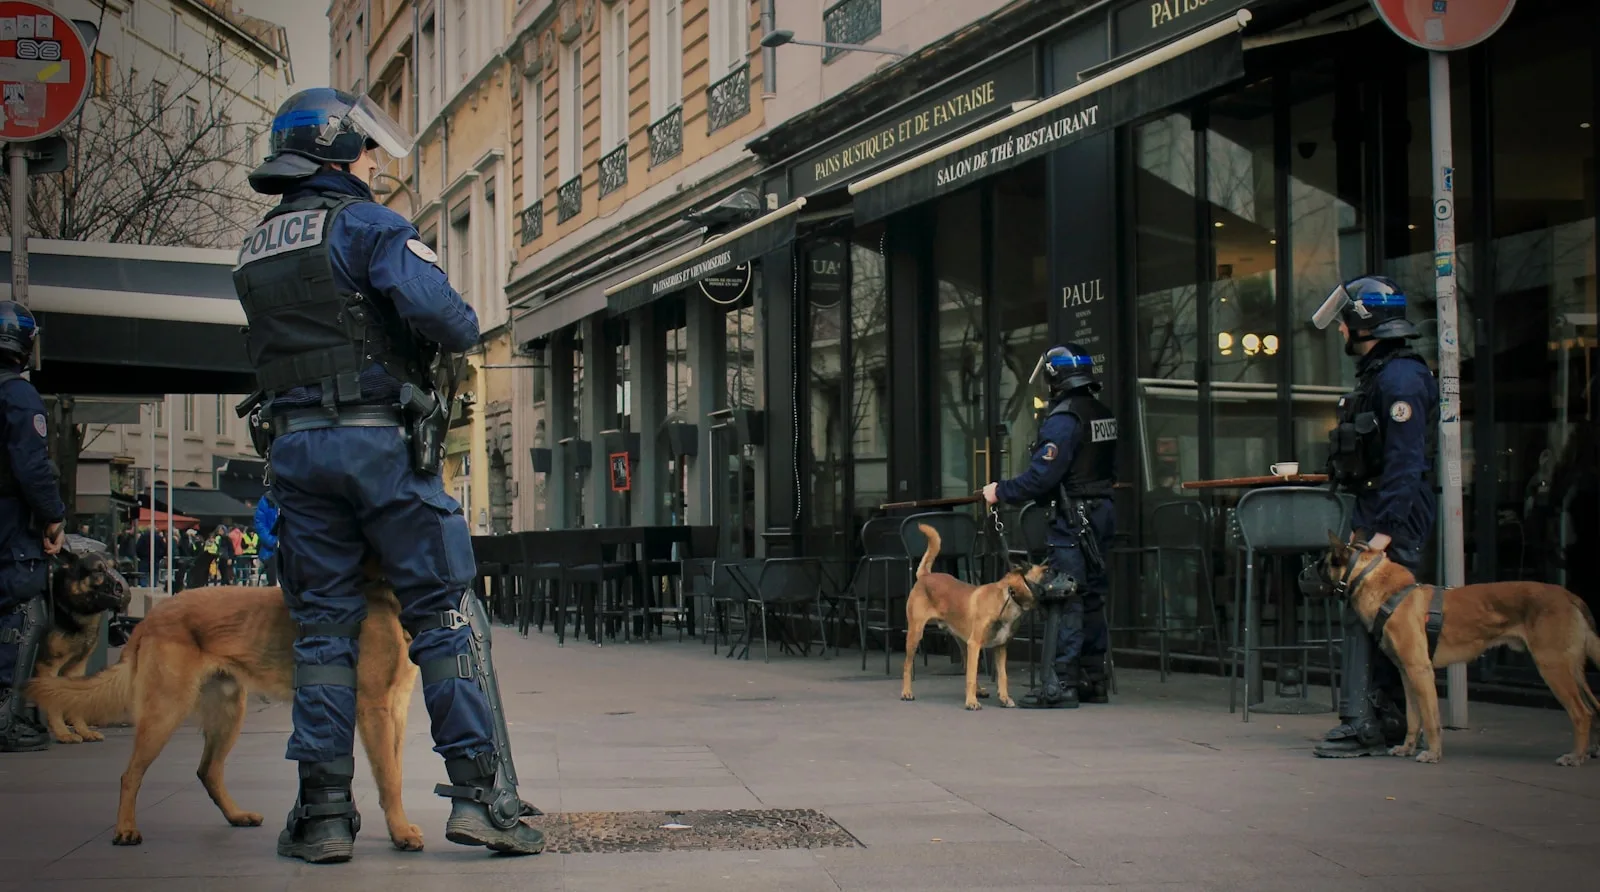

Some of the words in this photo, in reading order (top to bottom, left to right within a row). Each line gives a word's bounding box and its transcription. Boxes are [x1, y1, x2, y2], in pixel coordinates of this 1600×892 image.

[815, 154, 840, 180] PAINS
[843, 129, 895, 166] RUSTIQUES
[899, 119, 911, 143] ET
[915, 111, 930, 136] DE
[934, 81, 995, 126] FANTAISIE
[937, 157, 972, 186] SALON
[973, 151, 988, 172] DE
[991, 132, 1015, 164] THÉ
[1016, 105, 1099, 153] RESTAURANT
[240, 214, 320, 256] POLICE
[1062, 279, 1105, 308] PAUL
